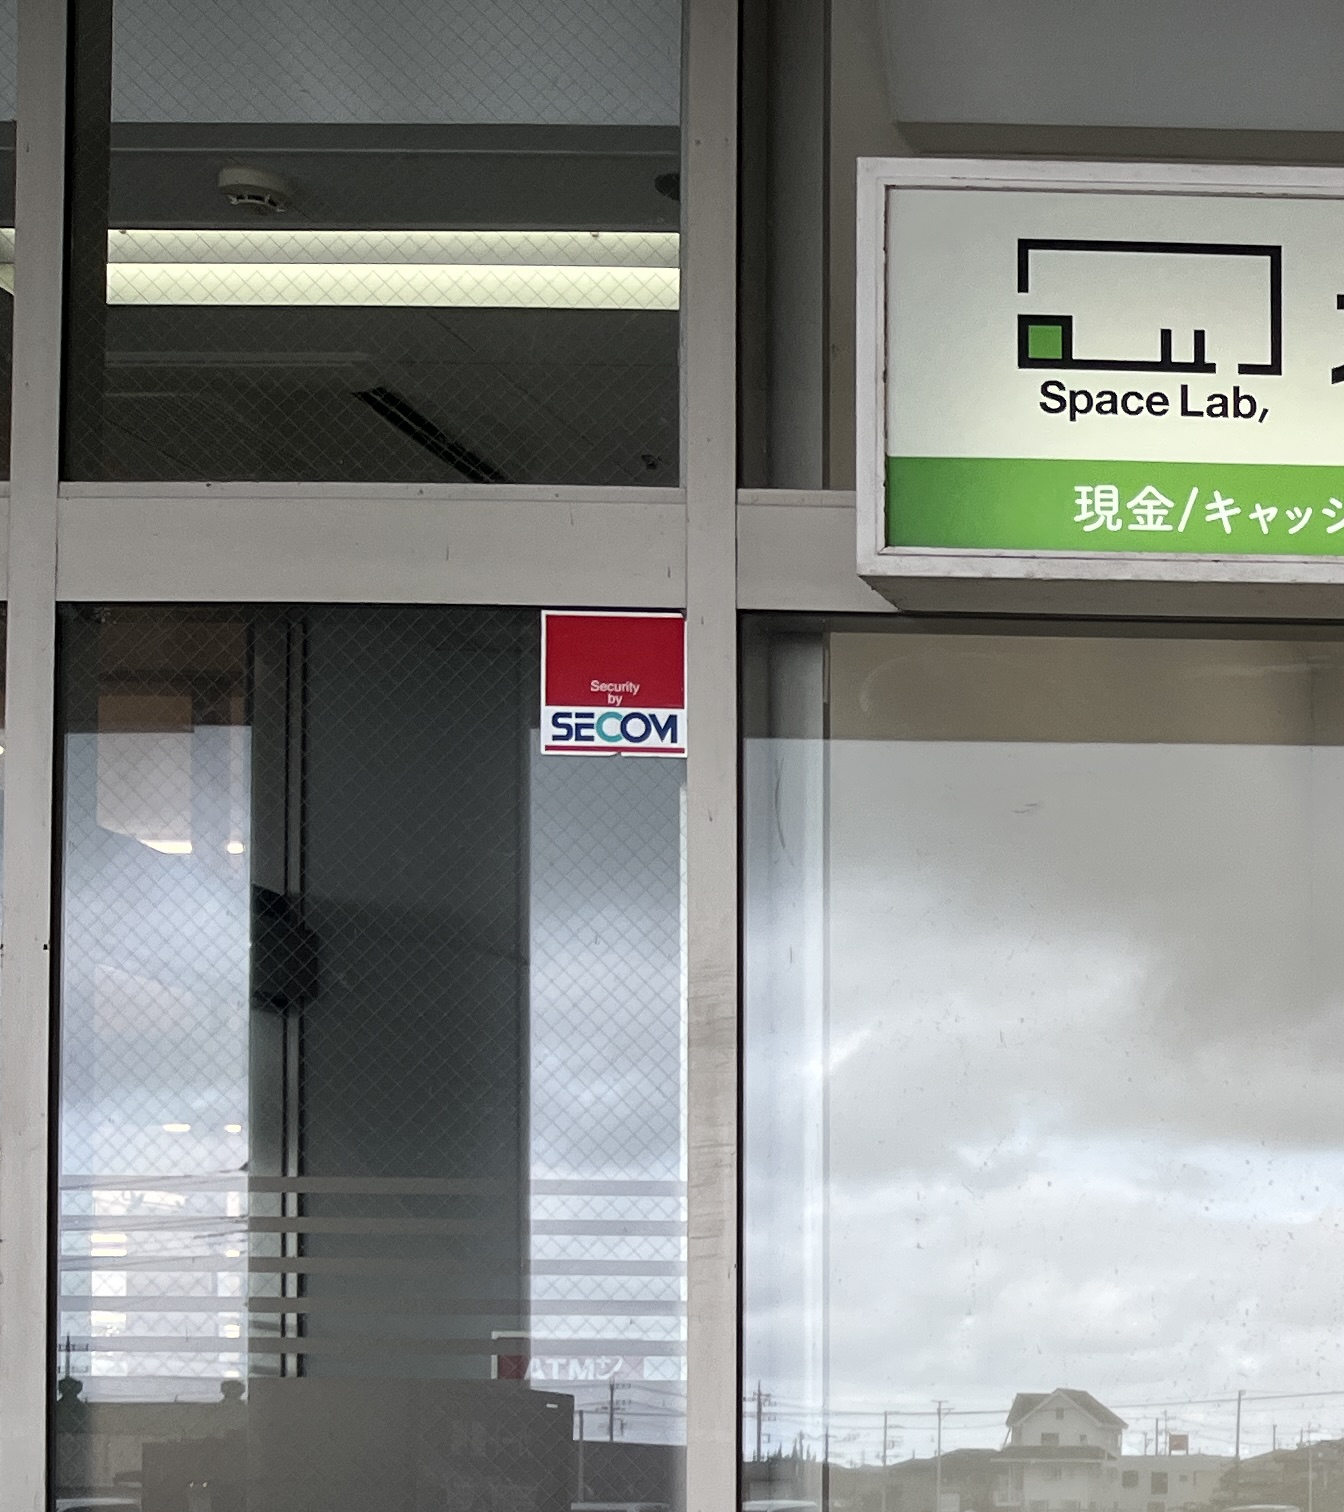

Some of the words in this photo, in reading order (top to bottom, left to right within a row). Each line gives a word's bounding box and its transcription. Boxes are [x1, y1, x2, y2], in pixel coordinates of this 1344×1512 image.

[1040, 381, 1169, 421] Space
[1181, 384, 1268, 423] Lab,
[591, 680, 640, 696] Security
[608, 694, 622, 706] by
[552, 712, 677, 743] SECOM
